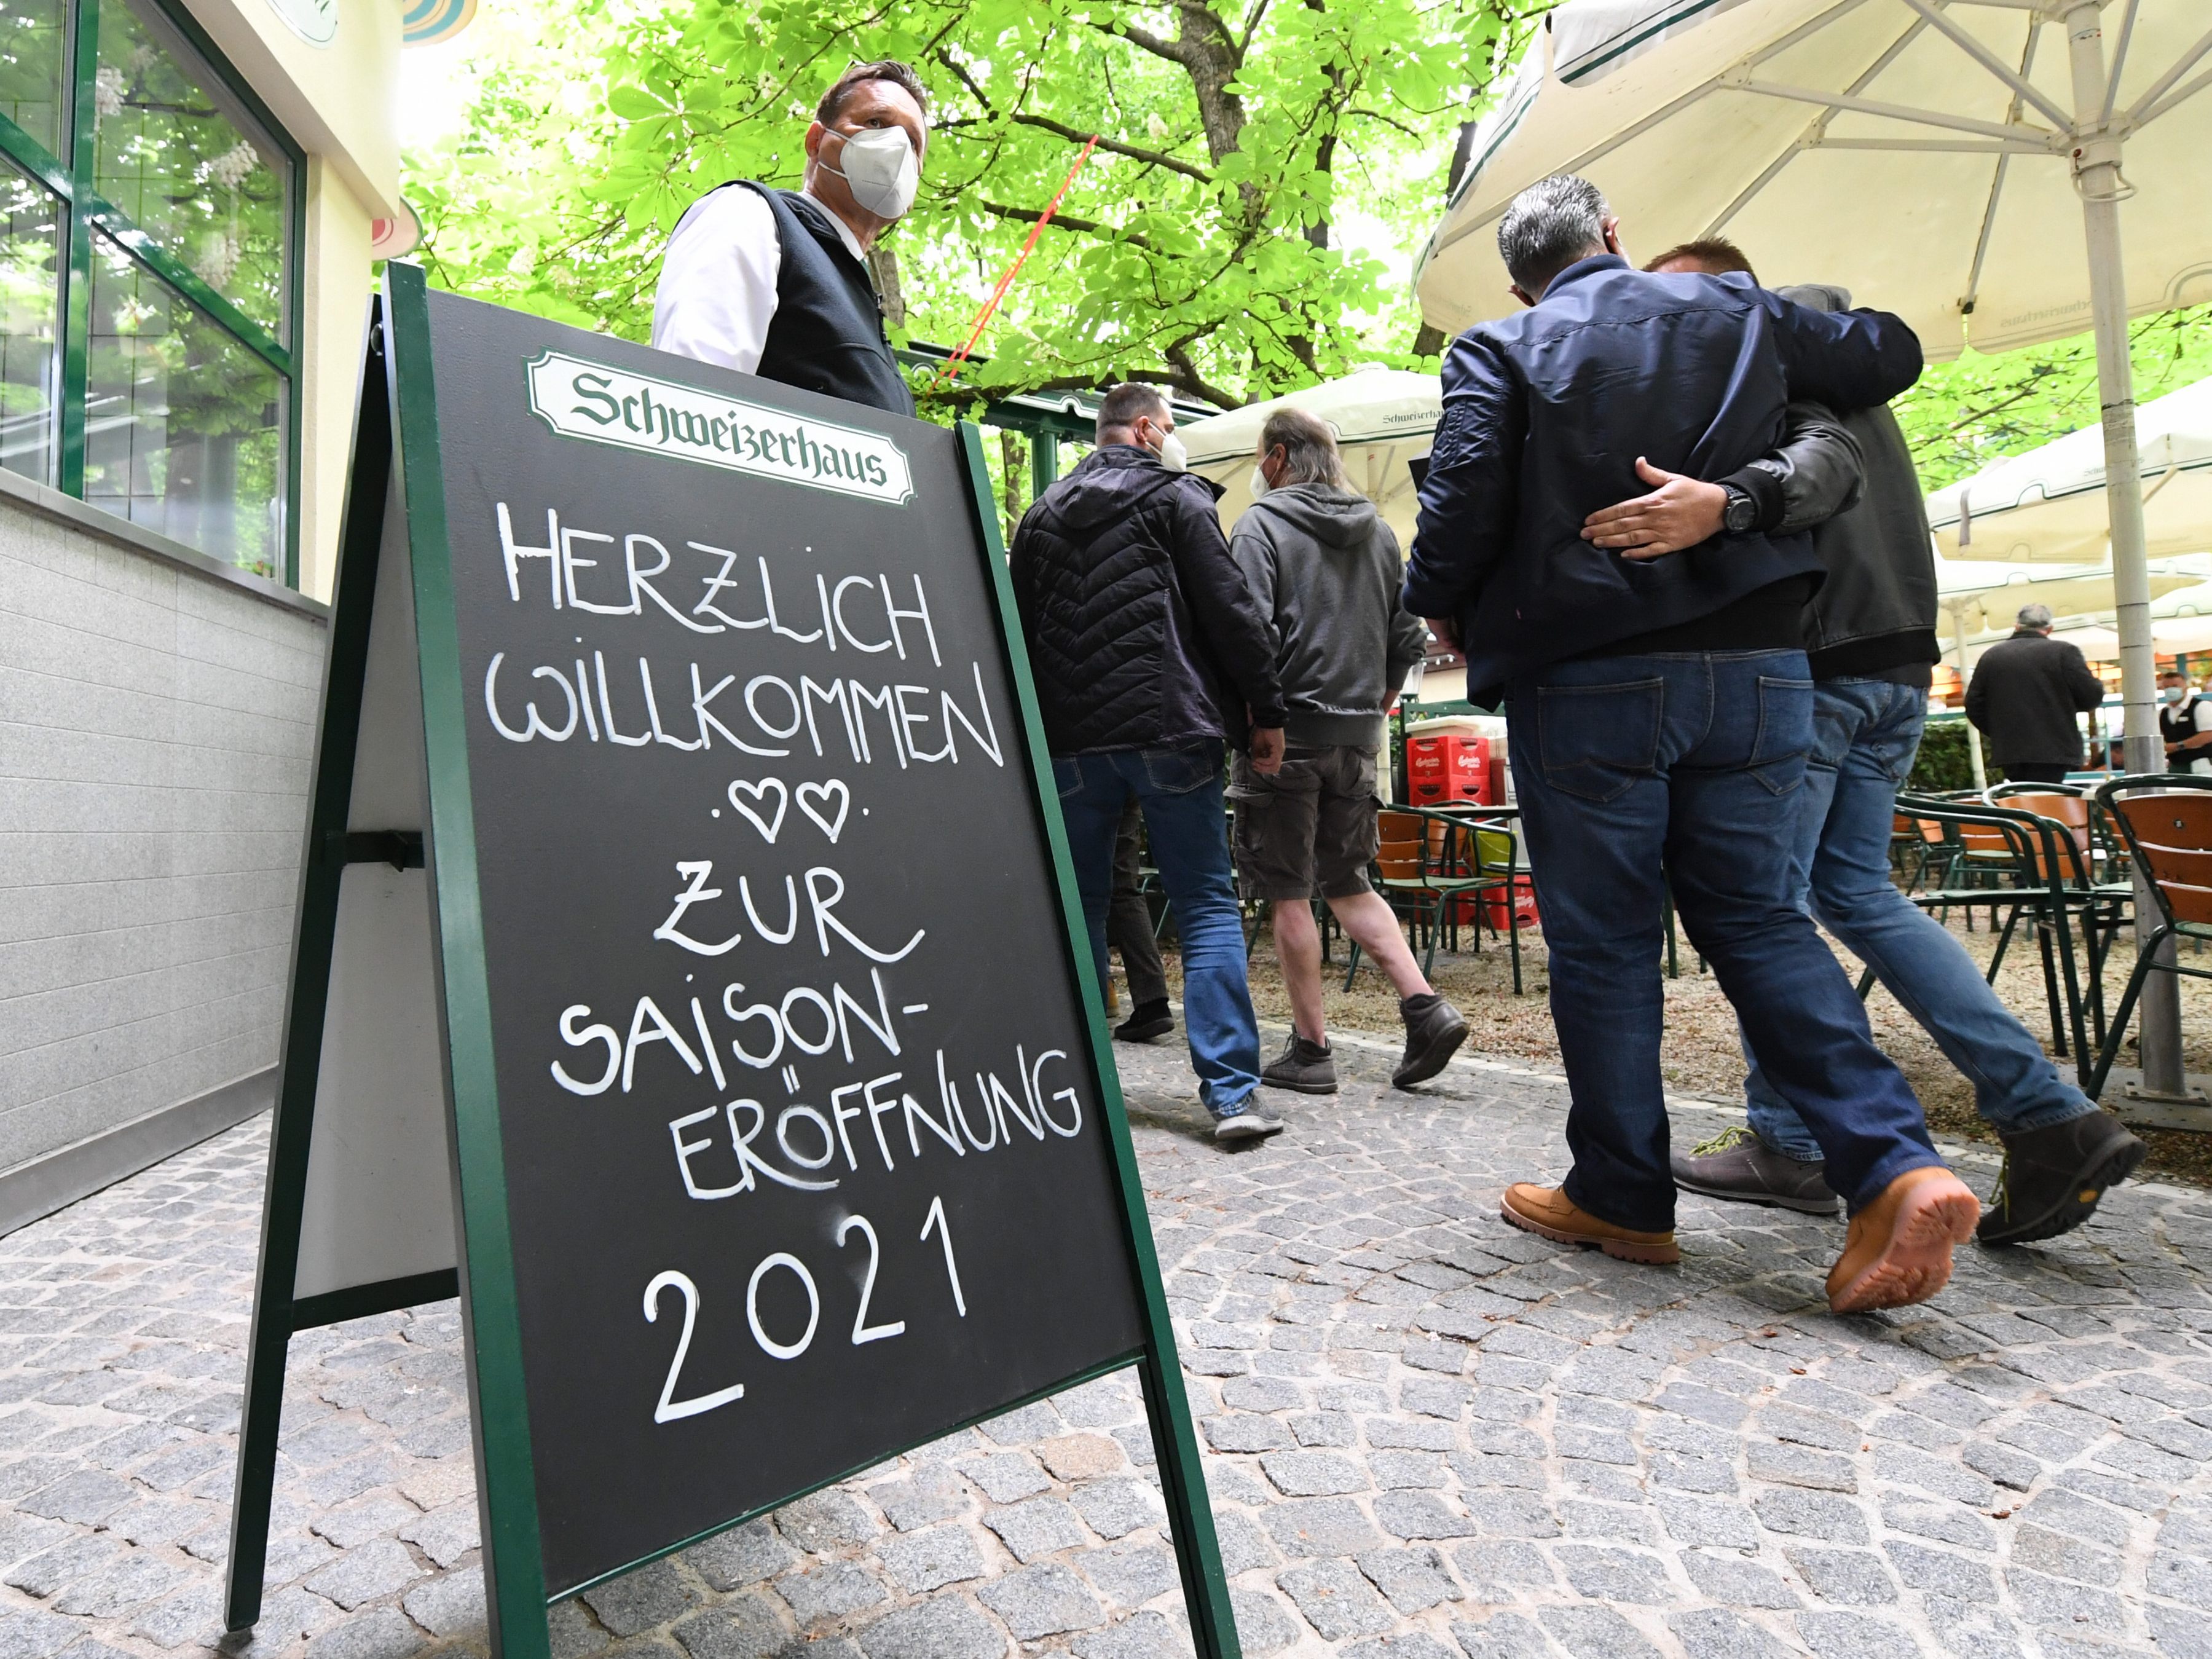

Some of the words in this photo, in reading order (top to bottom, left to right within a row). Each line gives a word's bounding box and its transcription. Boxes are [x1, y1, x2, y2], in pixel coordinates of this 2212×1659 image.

[570, 372, 888, 487] Schweizerhaus
[1382, 409, 1443, 424] Schweizerha
[653, 860, 926, 963] ZUR
[669, 1043, 1082, 1200] ERÖFFNUNG
[643, 1196, 967, 1424] 2021
